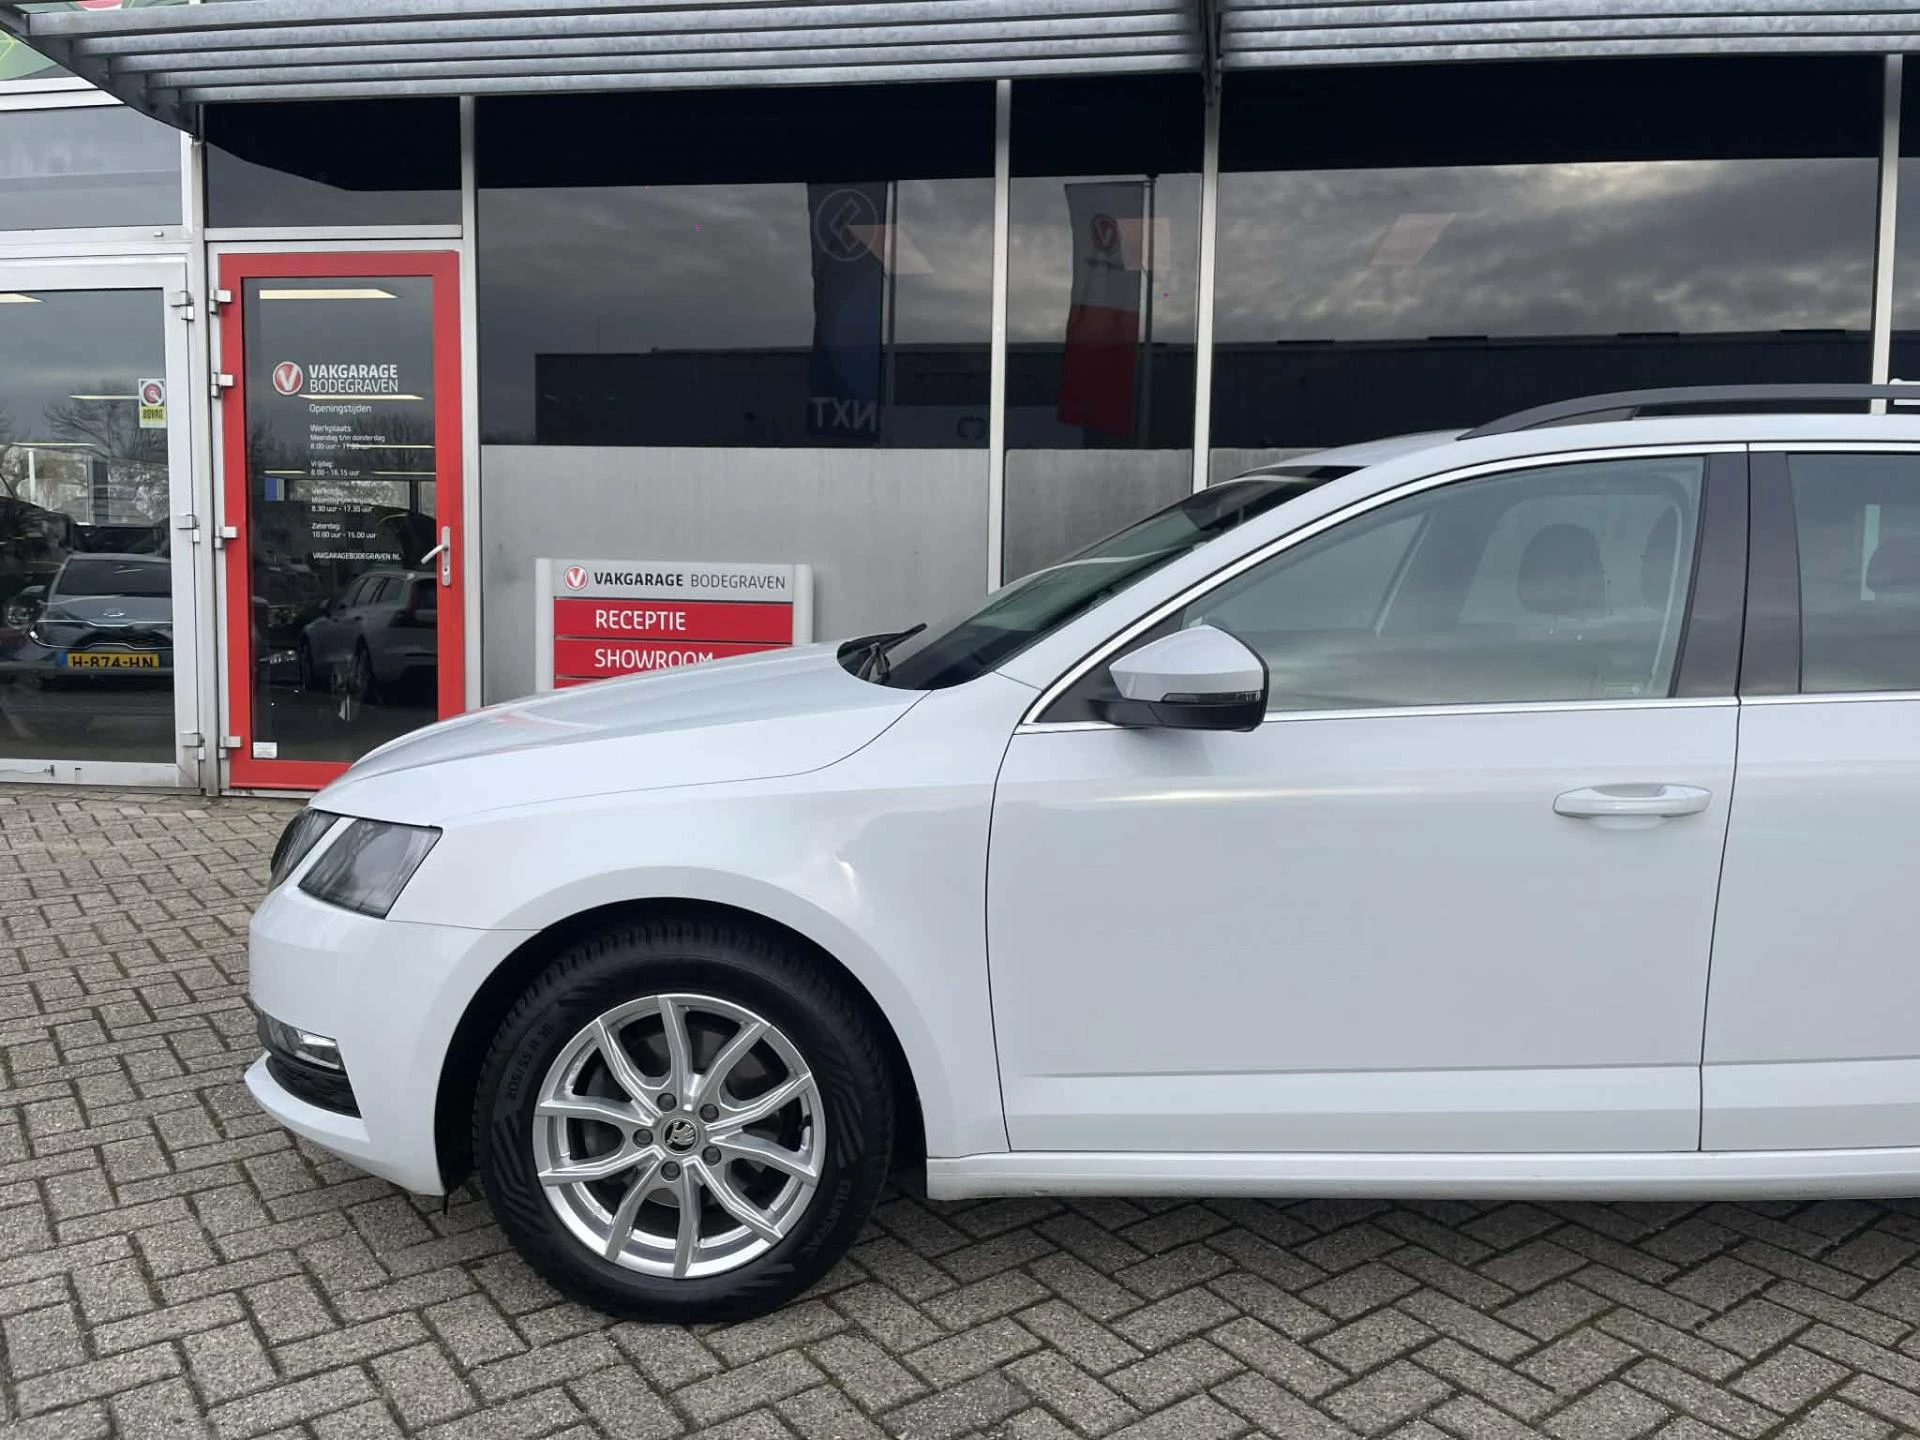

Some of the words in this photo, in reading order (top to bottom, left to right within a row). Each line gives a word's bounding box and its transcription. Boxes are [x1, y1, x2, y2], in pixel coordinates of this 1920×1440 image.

[308, 364, 398, 379] VAKGARAGE
[309, 378, 399, 393] BODEGRAVEN
[309, 403, 372, 415] Openingstijden
[352, 434, 386, 443] donderdag
[594, 571, 684, 588] VAKGARAGE
[690, 574, 786, 590] BODEGRAVEN
[595, 609, 687, 631] RECEPTIE
[594, 648, 714, 670] SHOWROOM
